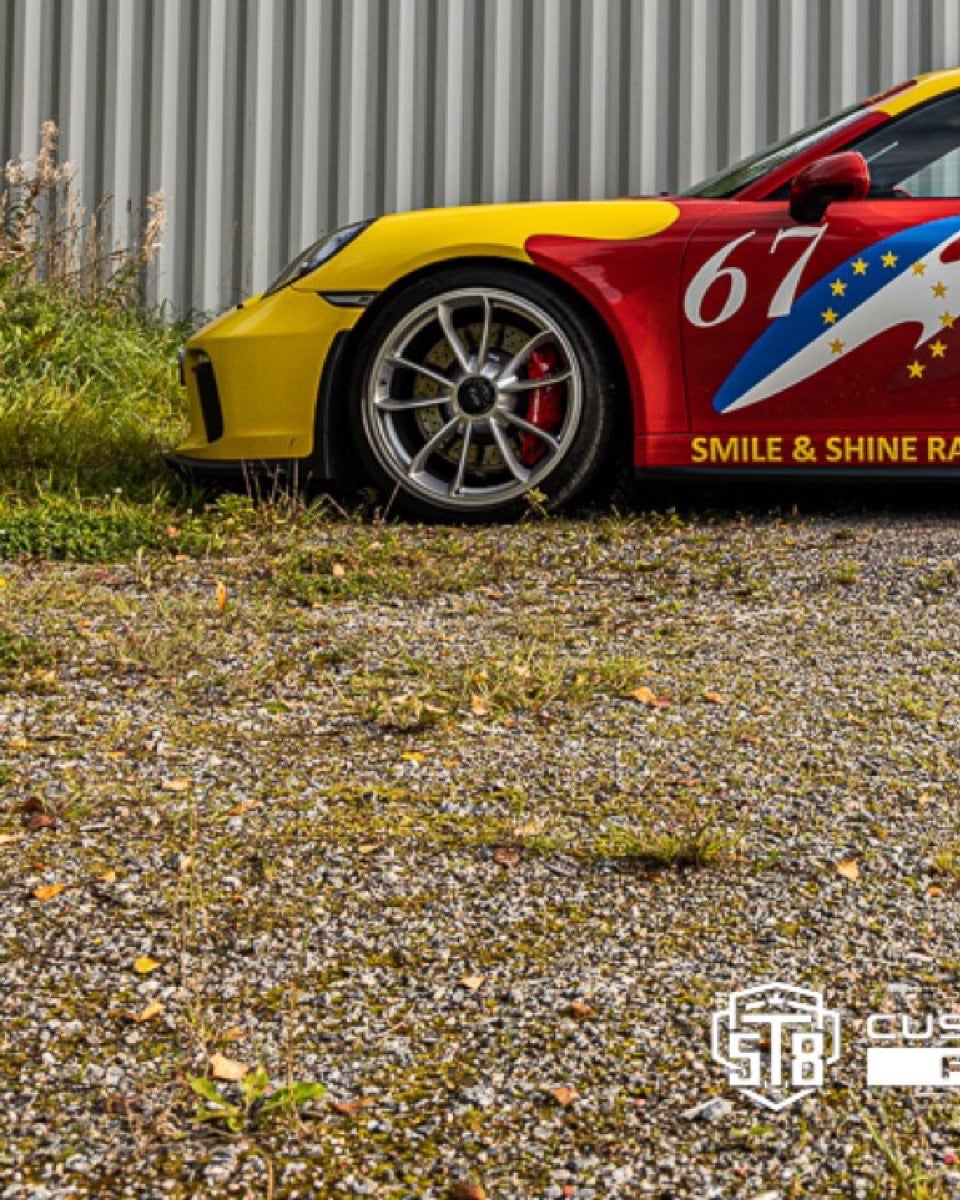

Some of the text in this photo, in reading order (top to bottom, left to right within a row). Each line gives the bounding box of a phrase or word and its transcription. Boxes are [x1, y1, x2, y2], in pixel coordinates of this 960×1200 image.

[683, 222, 829, 328] 67
[690, 436, 783, 462] SMILE
[791, 436, 817, 462] &
[825, 436, 919, 462] SHINE
